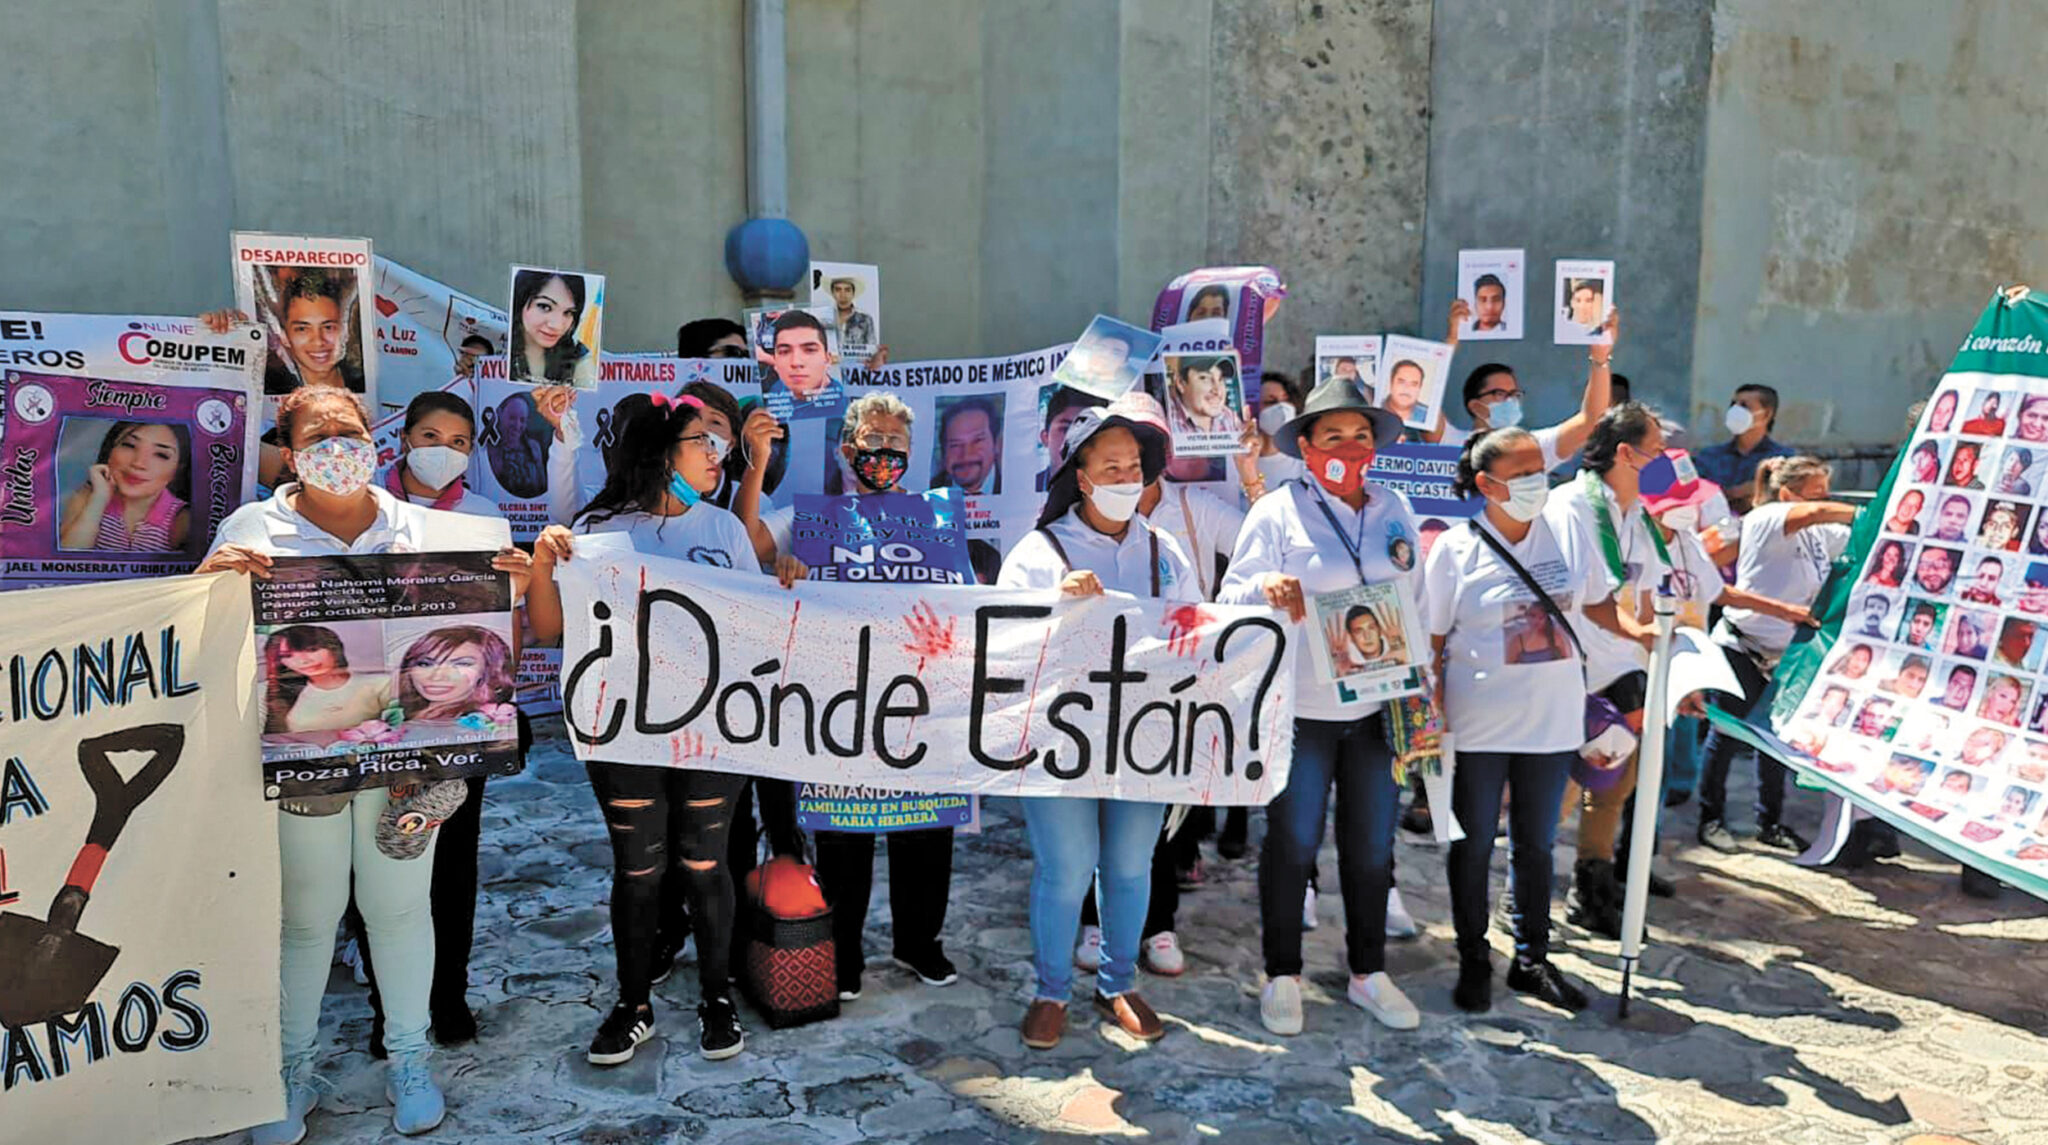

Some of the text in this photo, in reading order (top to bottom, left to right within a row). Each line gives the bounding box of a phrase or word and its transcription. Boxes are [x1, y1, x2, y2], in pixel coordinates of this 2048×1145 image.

[241, 249, 366, 265] DESAPARECIDO
[1972, 333, 2043, 354] corazón
[599, 362, 676, 382] ONTRARLES
[906, 364, 963, 386] ESTADO
[968, 364, 988, 383] DE
[992, 356, 1046, 381] MÉXICO
[86, 381, 166, 415] Siempre
[1369, 457, 1456, 476] LERMO DAVID
[2, 448, 37, 526] Unidas
[833, 543, 924, 564] NO
[5, 562, 35, 574] JAEL
[41, 562, 125, 574] MONSERRAT
[807, 565, 964, 584] ME OLVIDEN
[255, 581, 316, 592] Vanesa
[321, 578, 381, 588] Nahomi
[387, 575, 446, 586] Morales
[262, 586, 385, 599] Desaparecida en
[262, 601, 456, 621] El 2 de octubre Del 2013
[324, 596, 387, 607] Veracruz
[0, 624, 201, 722] IONAL
[564, 588, 1286, 781] ¿Dónde Están?
[355, 748, 422, 762] Herrera
[276, 751, 483, 784] Poza Rica, Ver.
[800, 796, 968, 814] FAMILIARES EN BUSQUEDA
[831, 811, 938, 826] MARIA HERRERA
[1, 970, 209, 1090] AMOS
